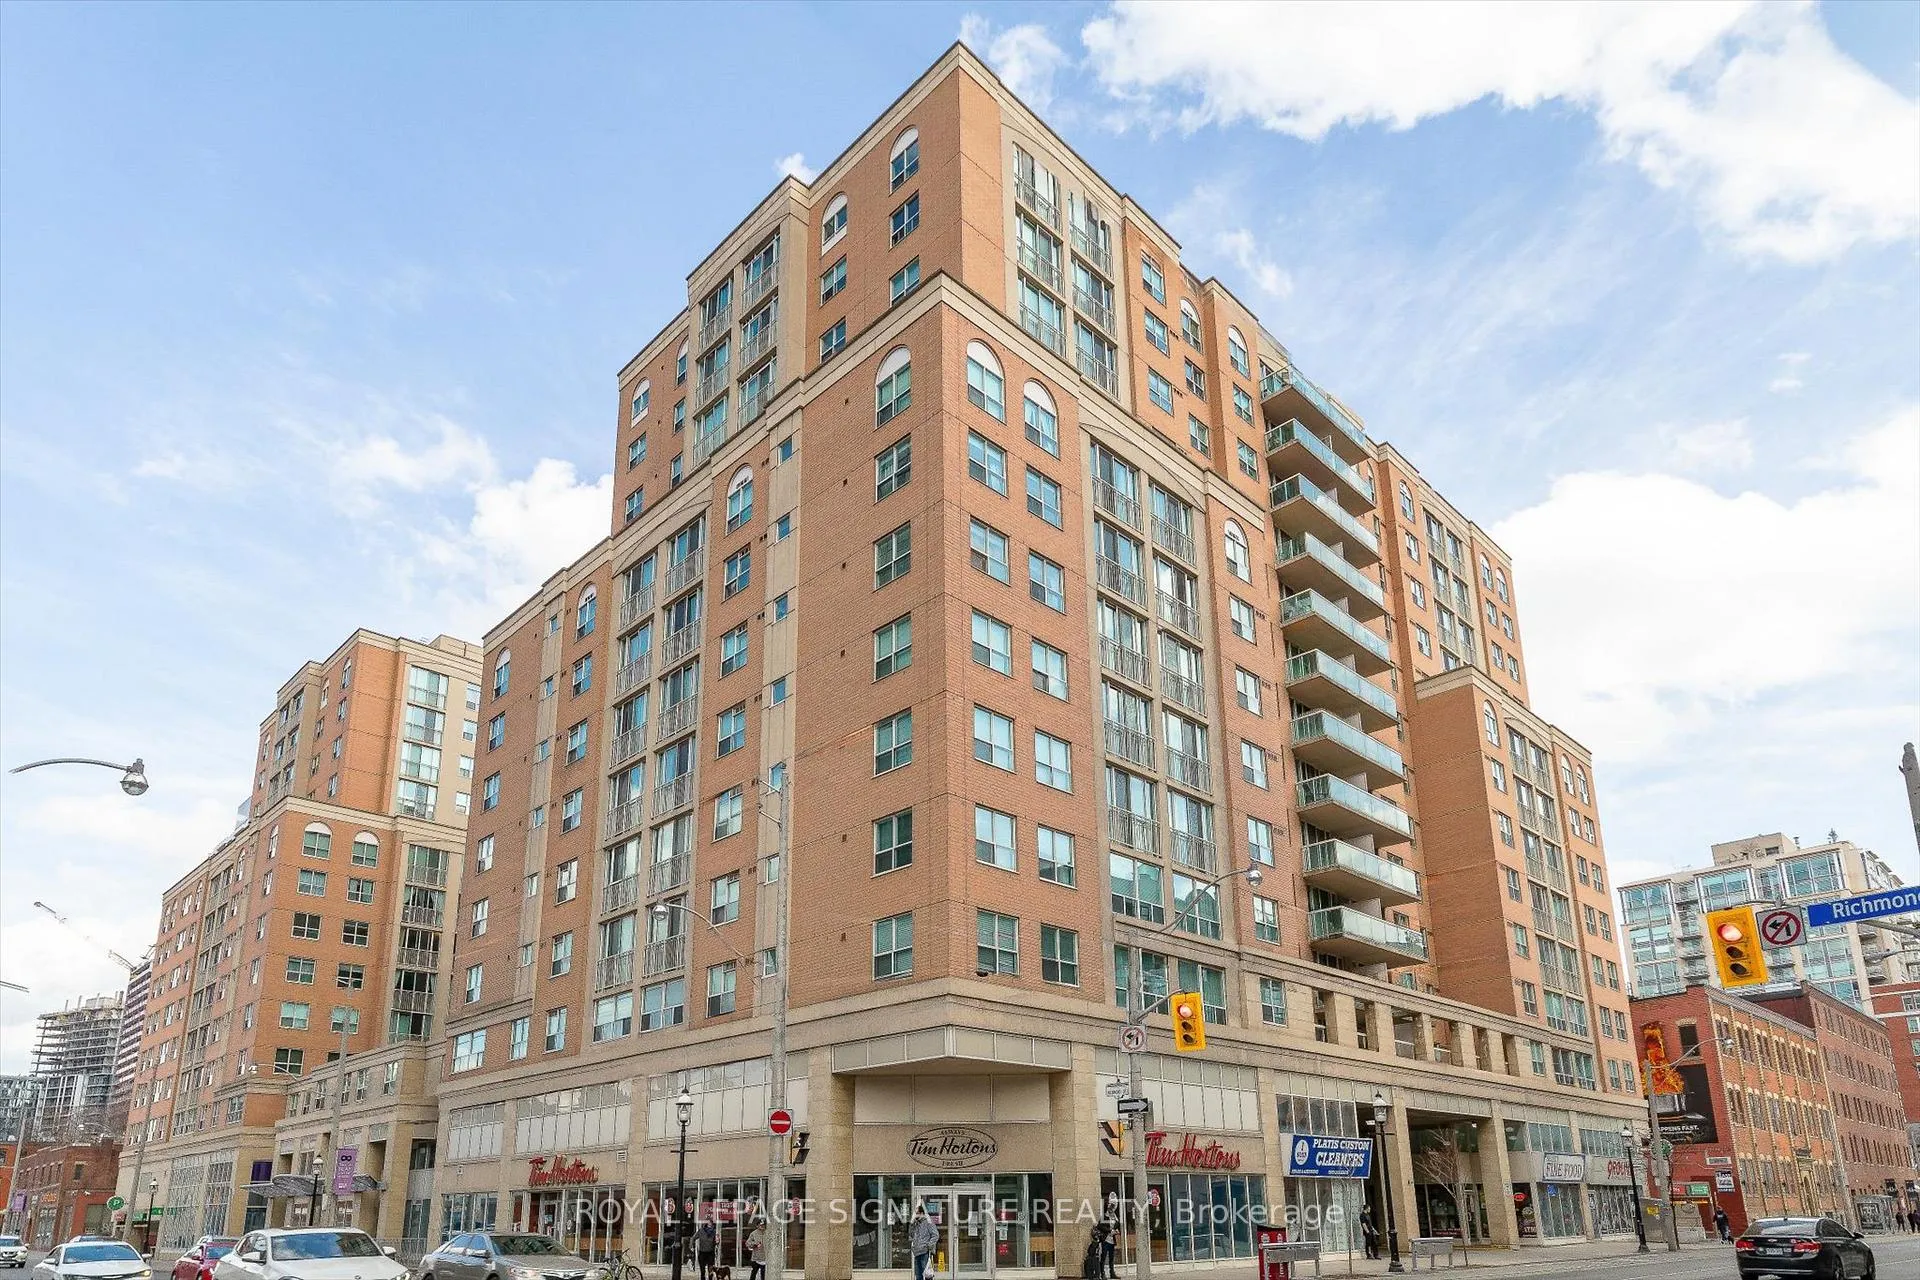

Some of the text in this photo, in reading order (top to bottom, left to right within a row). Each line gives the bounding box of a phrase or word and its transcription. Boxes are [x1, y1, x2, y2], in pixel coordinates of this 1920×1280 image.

[909, 1137, 996, 1155] Tim Hortons
[1144, 1131, 1240, 1171] Tim Hortons
[1340, 1140, 1370, 1150] CUSTOM
[1315, 1151, 1366, 1167] CLEANERS
[528, 1153, 599, 1187] Tim Hortons
[1546, 1162, 1582, 1178] FINE FOOD
